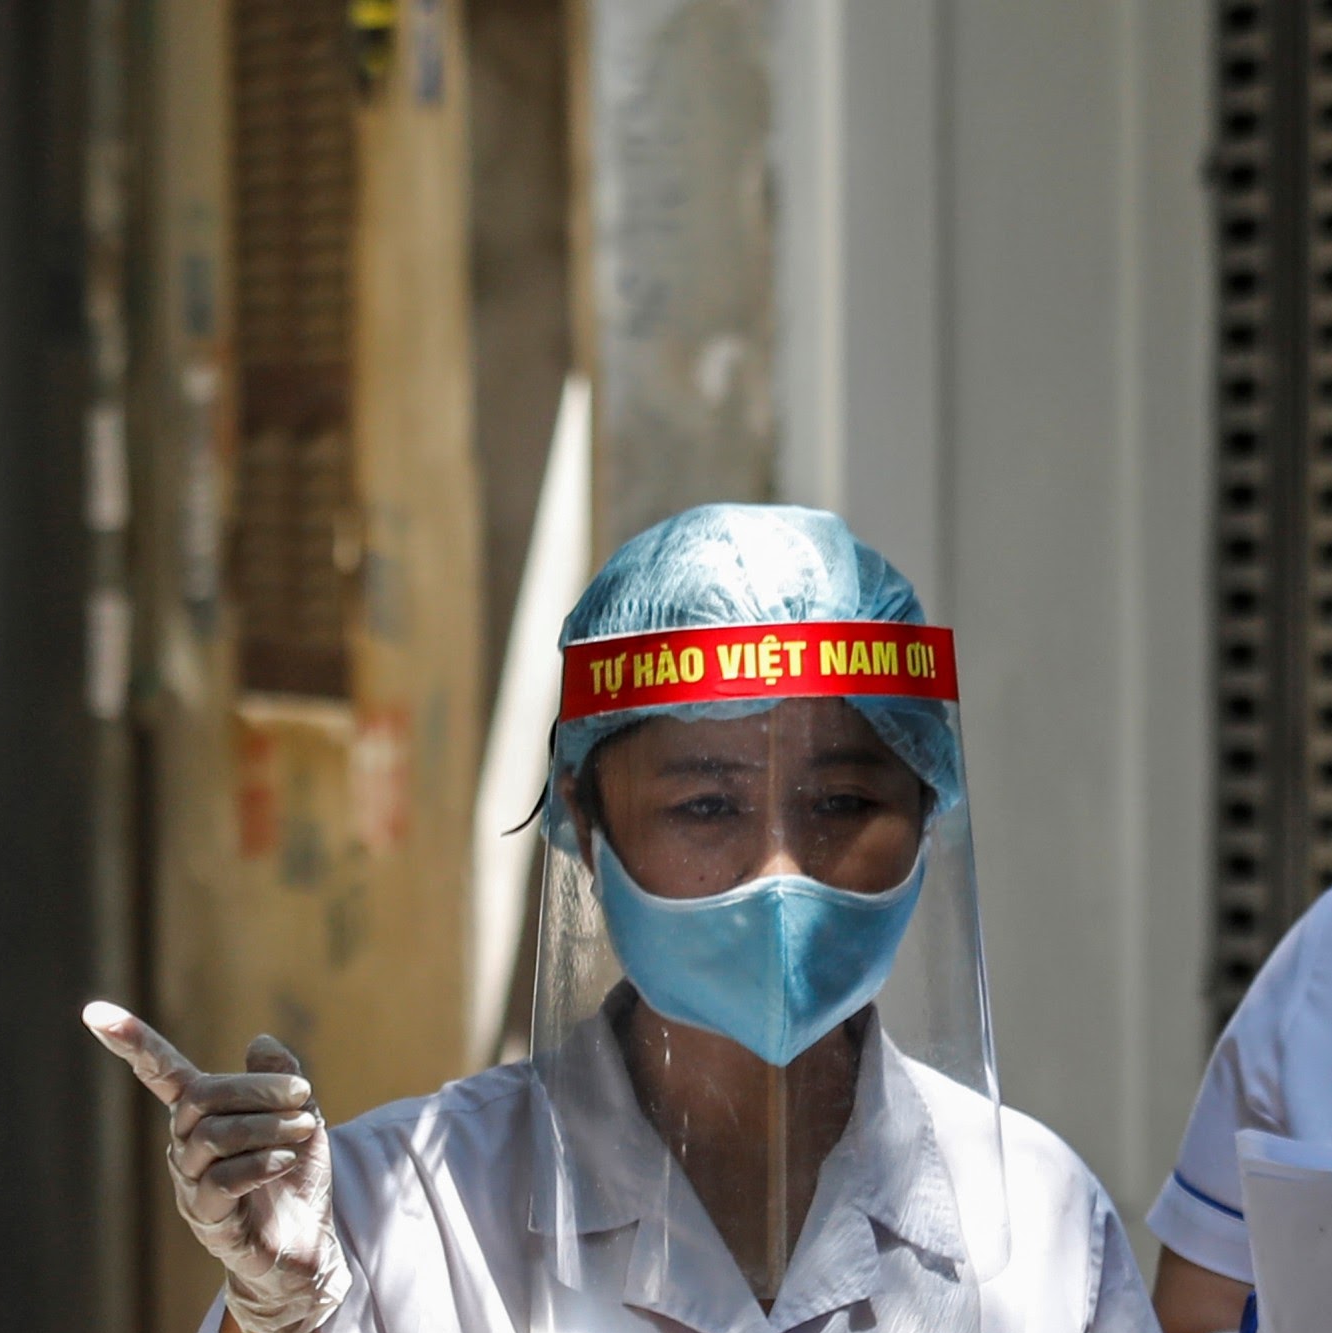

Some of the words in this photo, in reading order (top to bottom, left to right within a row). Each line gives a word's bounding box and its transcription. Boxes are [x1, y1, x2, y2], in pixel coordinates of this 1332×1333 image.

[590, 652, 626, 699] TỰ
[633, 642, 705, 689] HÀO
[717, 635, 807, 686] VIỆT
[820, 639, 899, 676] NAM
[906, 640, 937, 680] ƠI!
